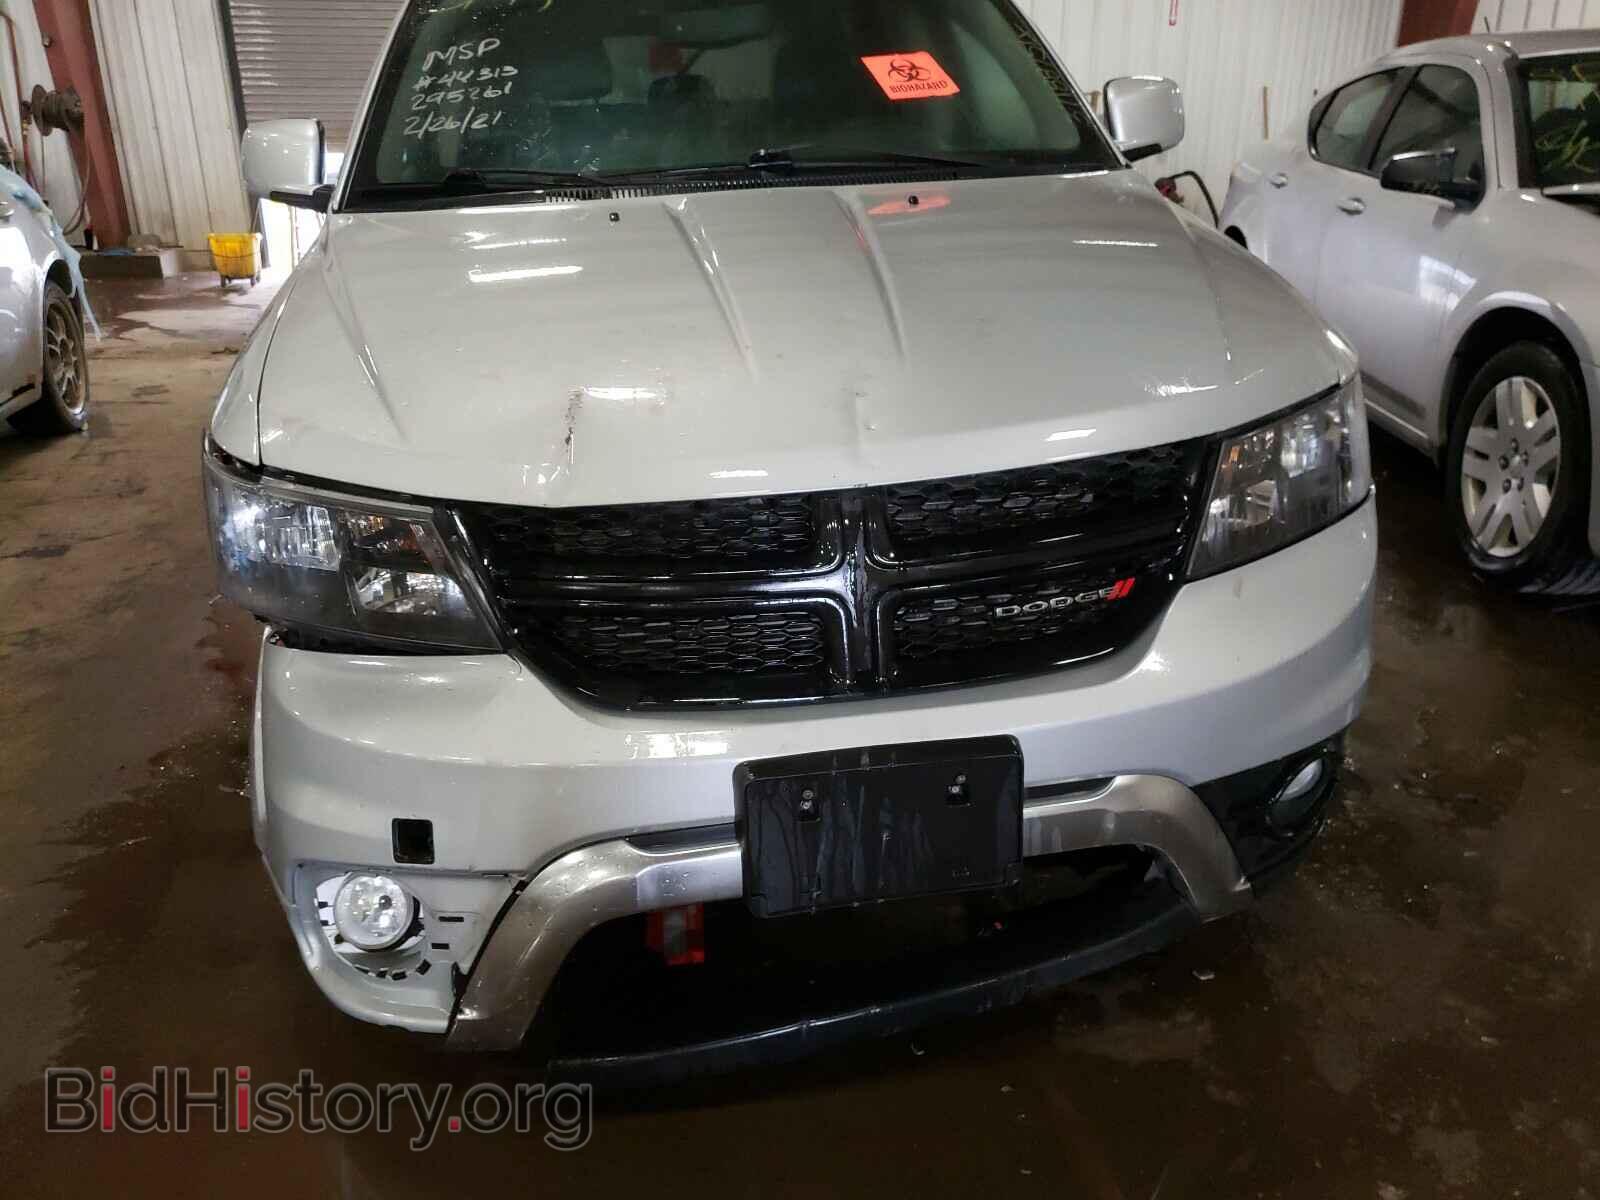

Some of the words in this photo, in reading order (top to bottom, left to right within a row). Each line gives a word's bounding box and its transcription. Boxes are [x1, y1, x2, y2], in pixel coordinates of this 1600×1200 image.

[422, 38, 501, 71] MSP
[889, 80, 948, 94] BIOHAZARD
[403, 106, 502, 139] 2/26/21
[995, 585, 1118, 617] DODGE
